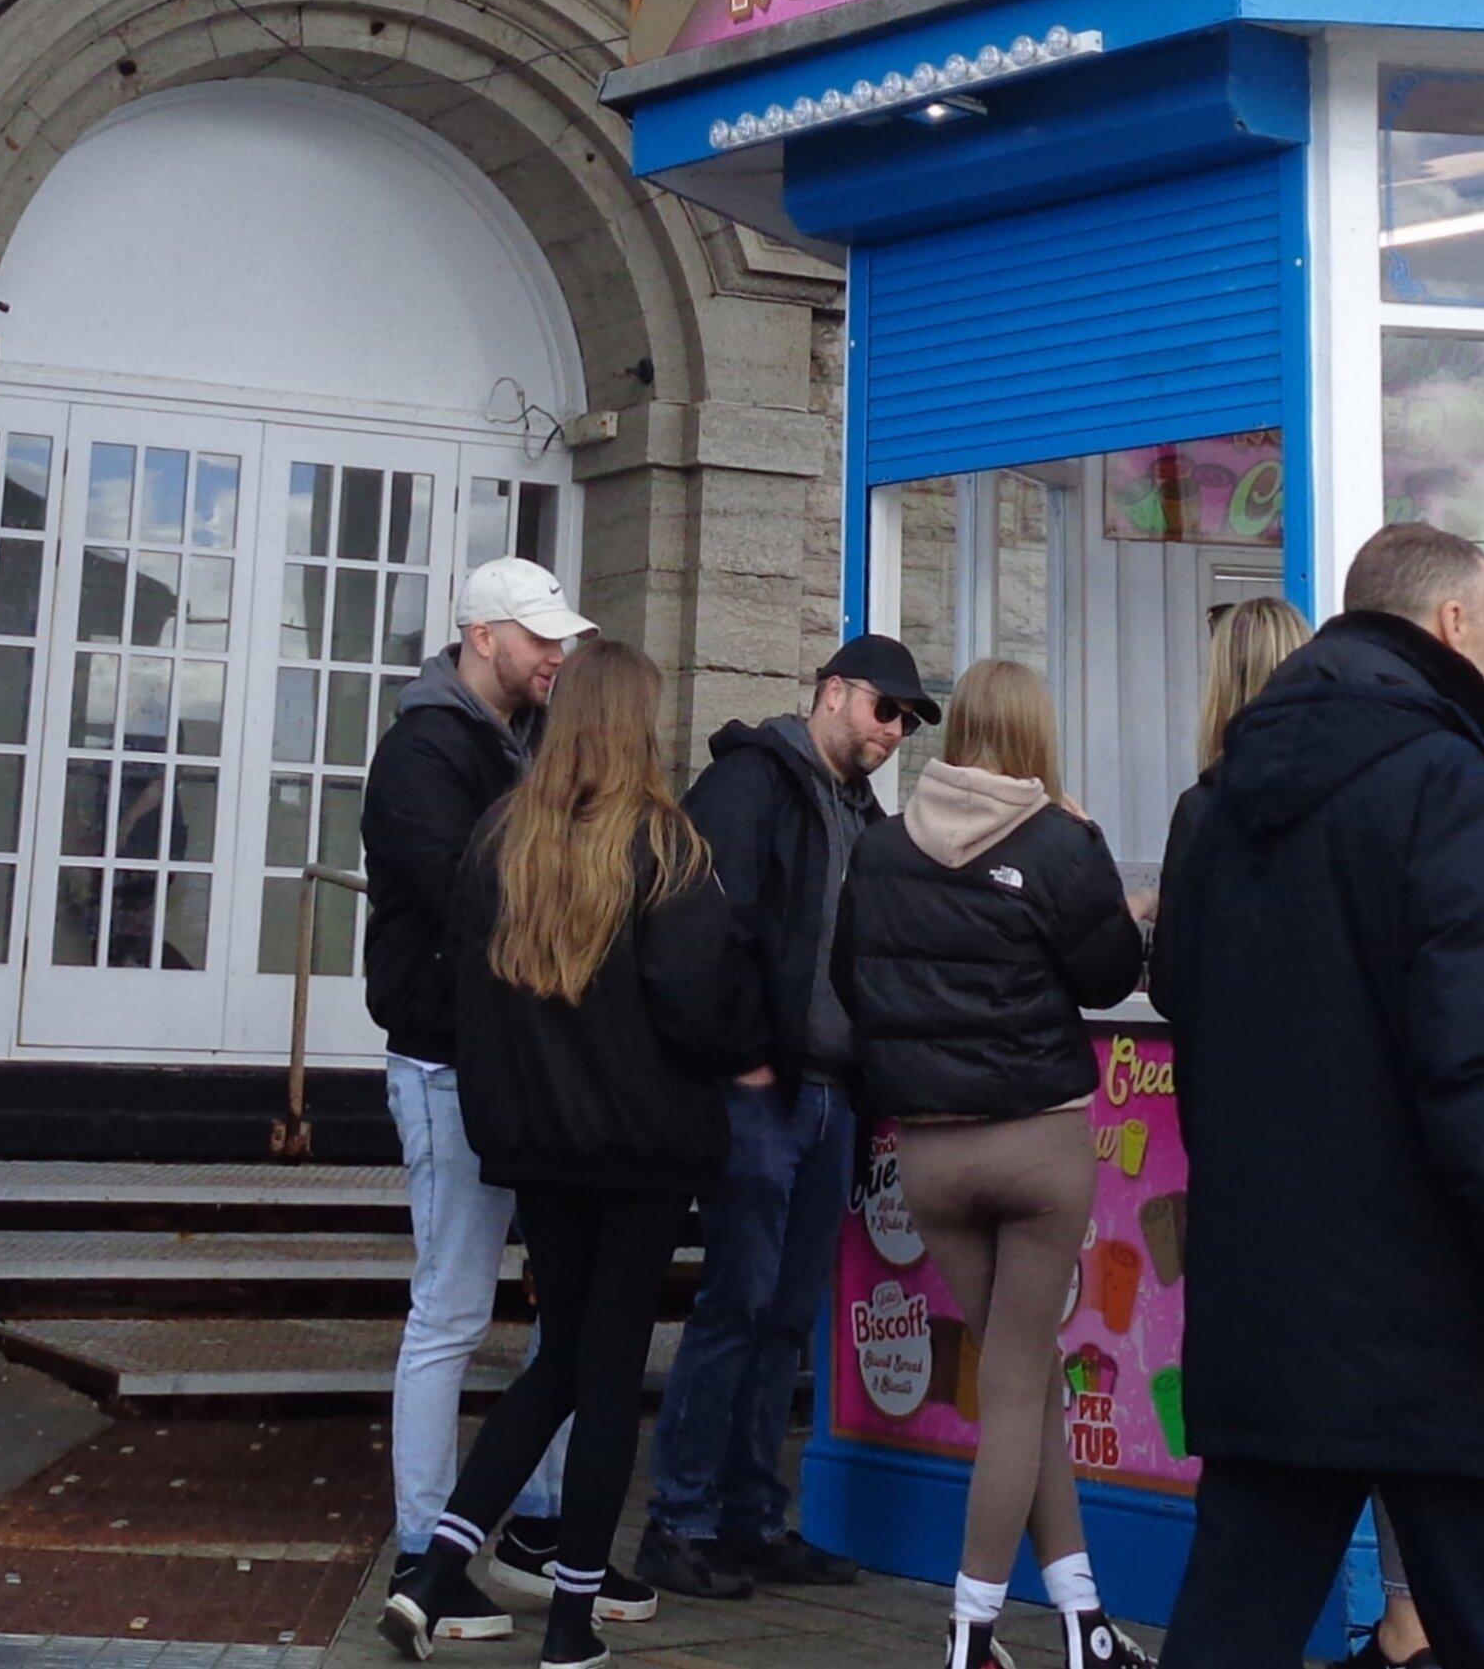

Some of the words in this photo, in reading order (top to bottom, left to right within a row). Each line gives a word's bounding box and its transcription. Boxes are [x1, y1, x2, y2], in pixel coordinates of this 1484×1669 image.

[1107, 1033, 1175, 1106] Crea
[854, 1298, 924, 1344] Biscoff
[1078, 1394, 1112, 1422] PER
[1072, 1424, 1118, 1466] TUB
